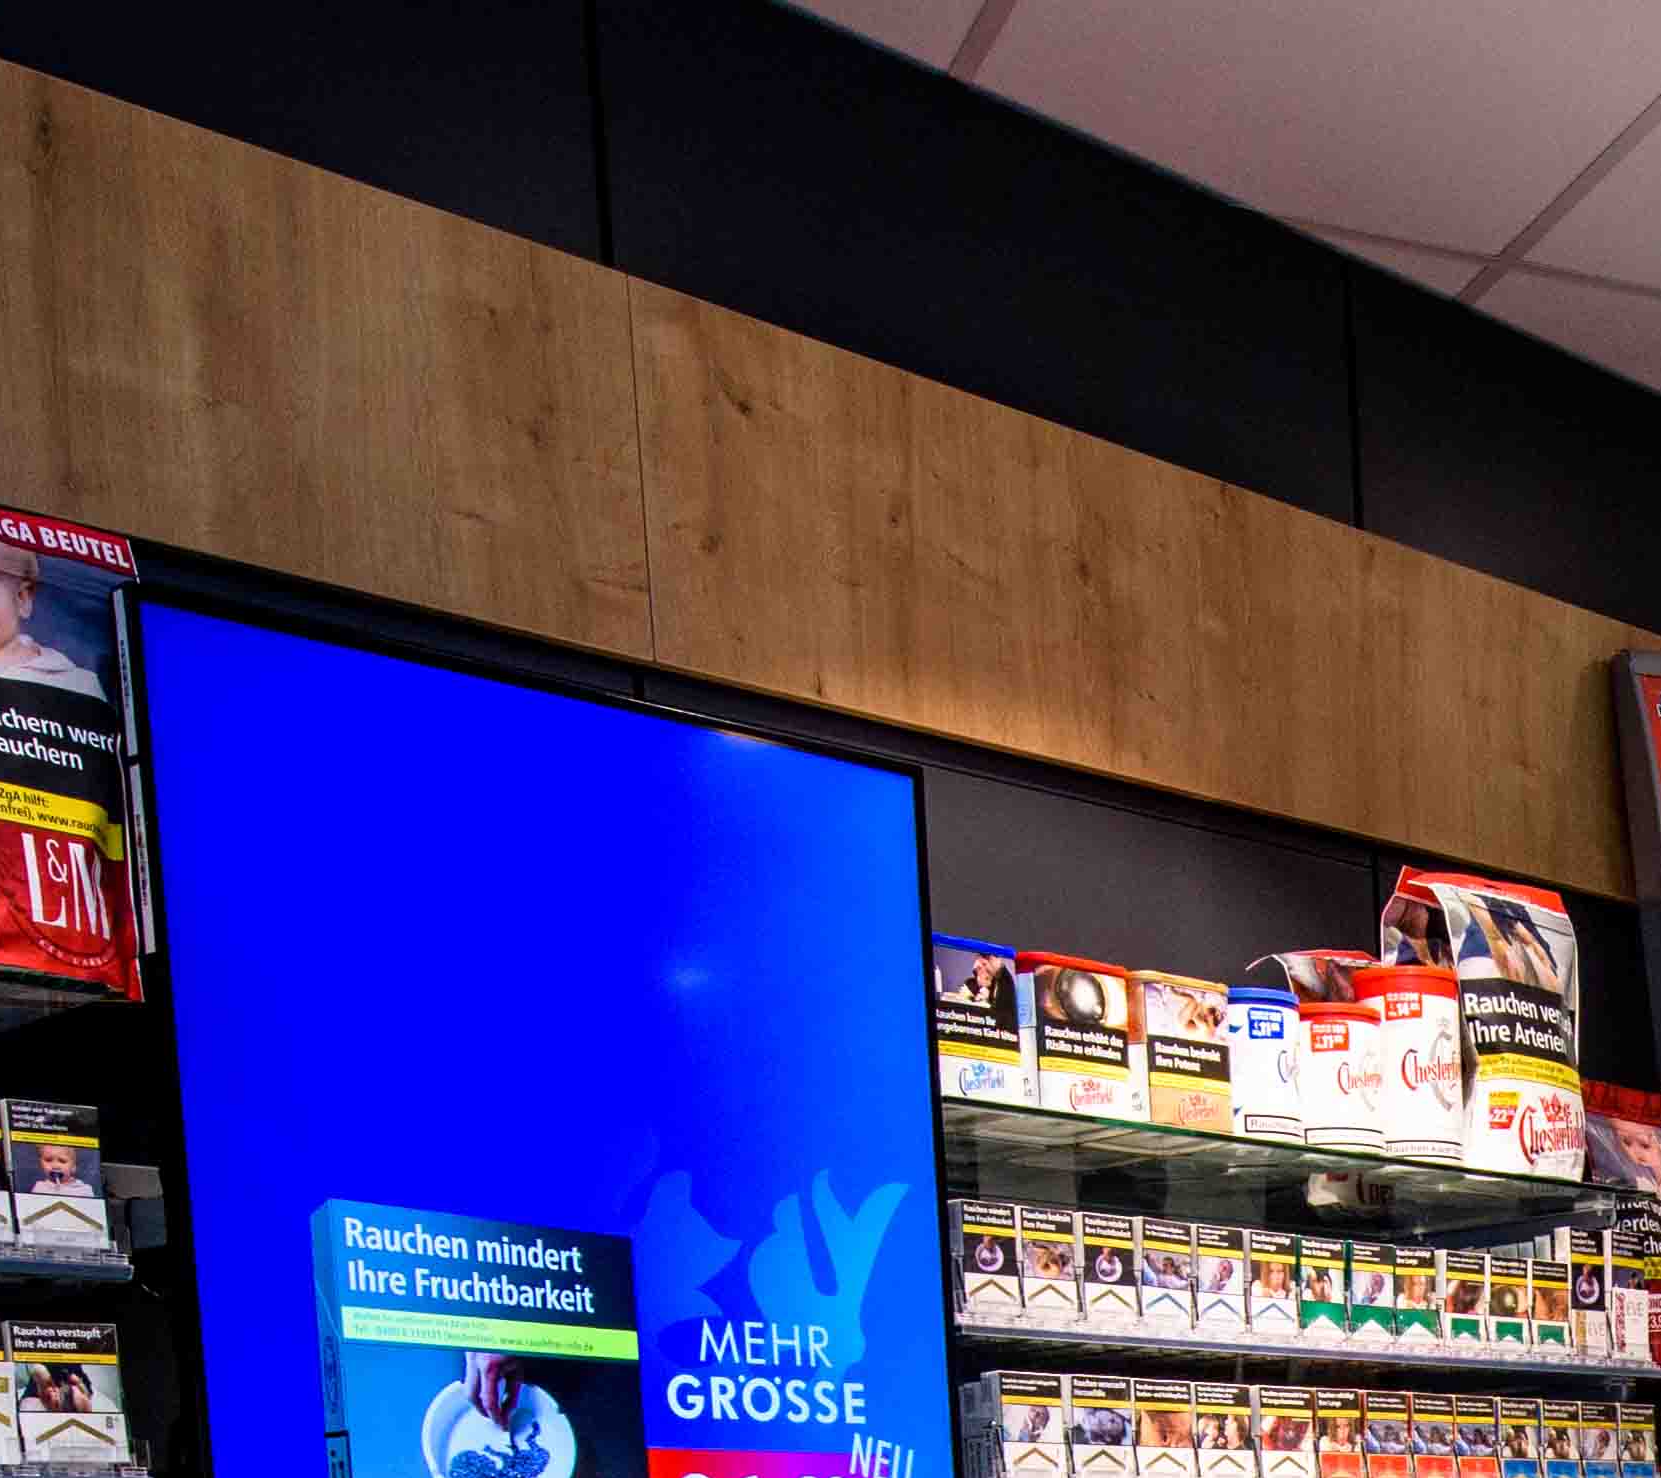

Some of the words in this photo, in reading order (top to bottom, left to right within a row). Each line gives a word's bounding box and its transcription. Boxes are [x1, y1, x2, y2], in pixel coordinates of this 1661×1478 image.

[39, 526, 131, 569] BEUTEL
[24, 791, 50, 809] hilft:
[21, 832, 111, 942] L&M
[343, 1217, 469, 1262] Rauchen
[476, 1235, 583, 1276] mindert
[347, 1261, 408, 1297] Ihre
[414, 1269, 595, 1316] Fruchtbarkeit
[700, 1317, 833, 1369] MEHR
[667, 1372, 867, 1425] GRÖSSE
